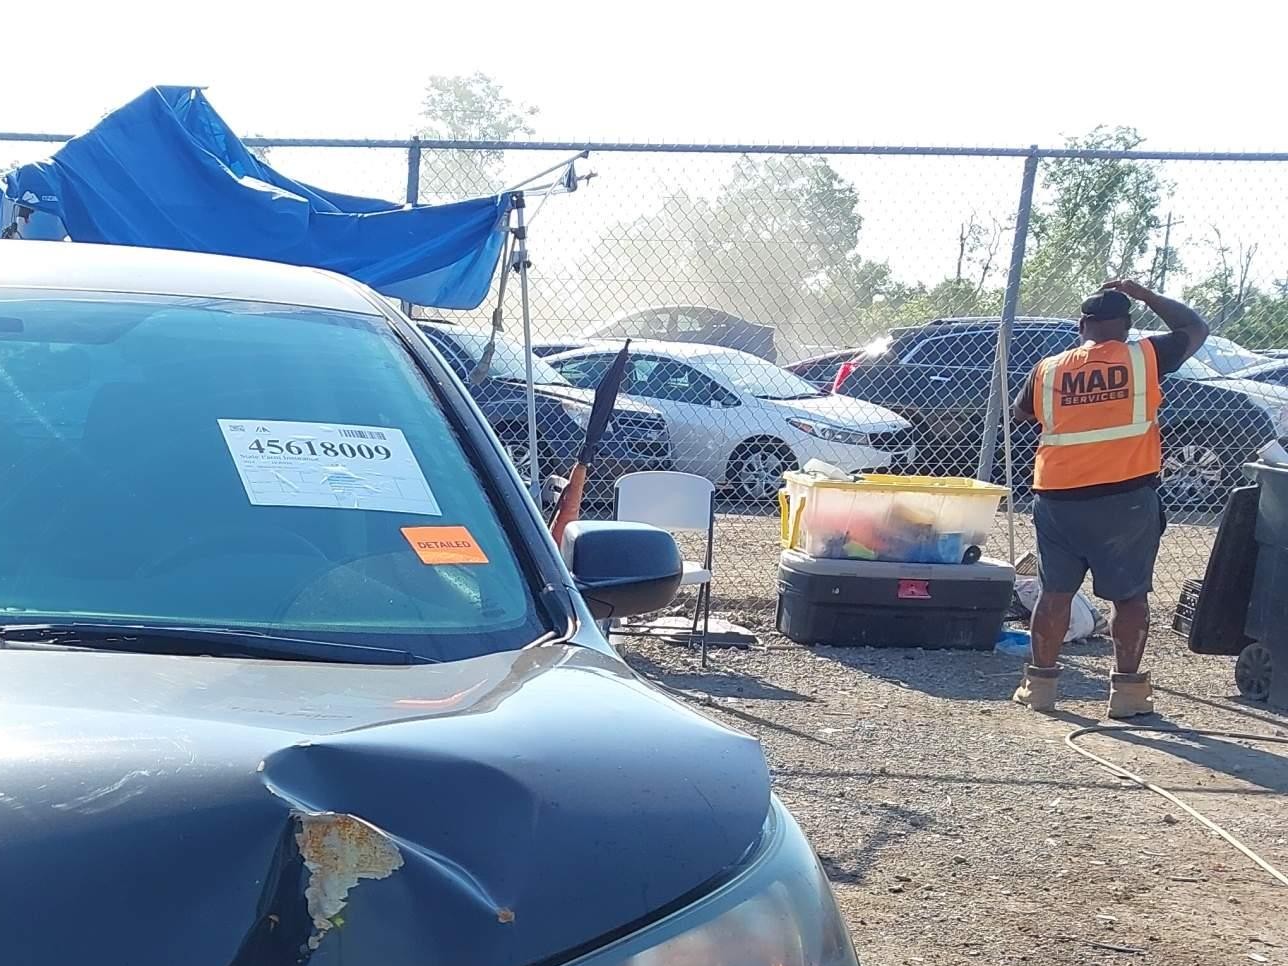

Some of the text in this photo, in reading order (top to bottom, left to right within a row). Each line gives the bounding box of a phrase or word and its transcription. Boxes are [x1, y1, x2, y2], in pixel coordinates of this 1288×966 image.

[1062, 366, 1128, 395] MAD
[1065, 391, 1125, 404] SERVICES
[248, 439, 392, 460] 45618009
[417, 540, 472, 549] DETAILED
